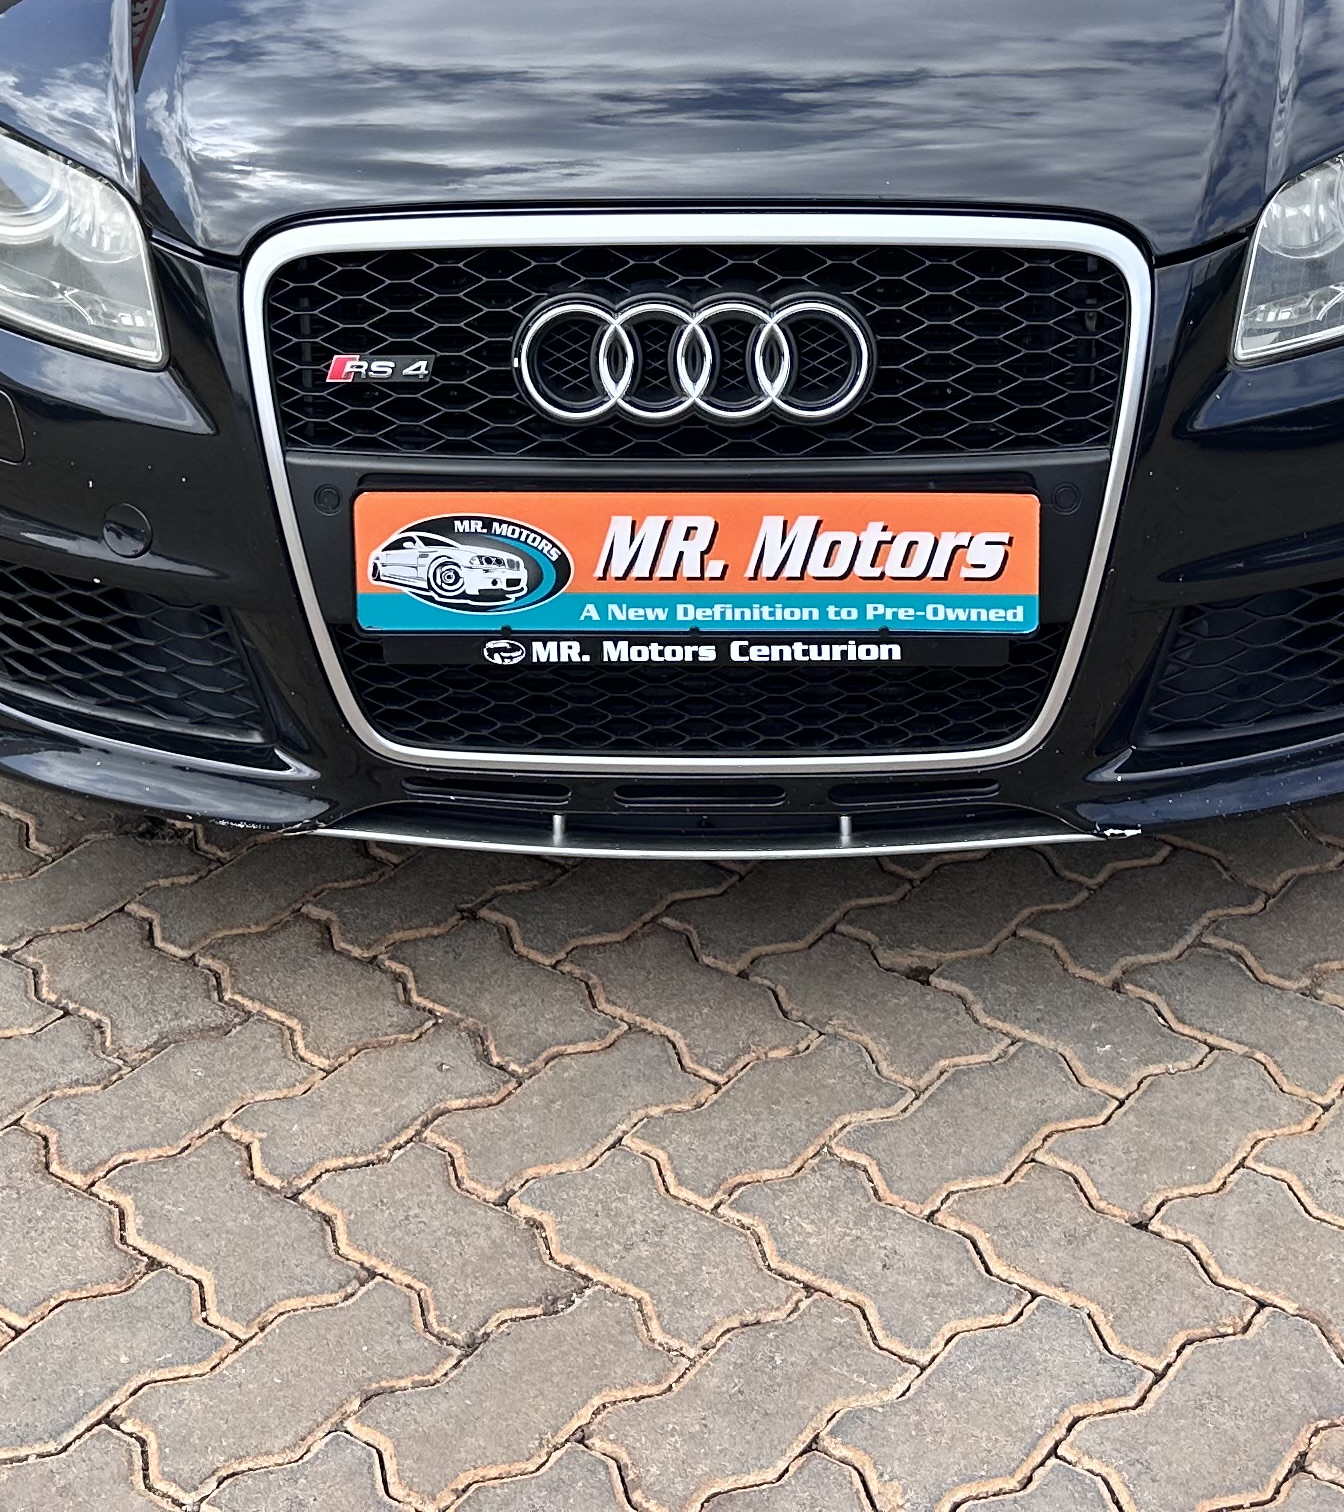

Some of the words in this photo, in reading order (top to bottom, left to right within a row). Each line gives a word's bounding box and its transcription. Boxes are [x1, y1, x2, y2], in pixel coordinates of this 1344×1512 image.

[338, 360, 396, 379] RS
[402, 360, 429, 379] 4
[454, 519, 488, 533] MR.
[491, 521, 562, 562] MOTORS
[594, 515, 726, 580] MR.
[744, 514, 1013, 581] Motors
[579, 604, 600, 622] A
[605, 604, 669, 622] New
[675, 603, 819, 623] Definition
[827, 605, 858, 623] to
[865, 603, 1025, 624] Pre-Owned
[531, 642, 591, 663] MR.
[602, 641, 717, 663] Motors
[730, 639, 902, 663] Centurion
